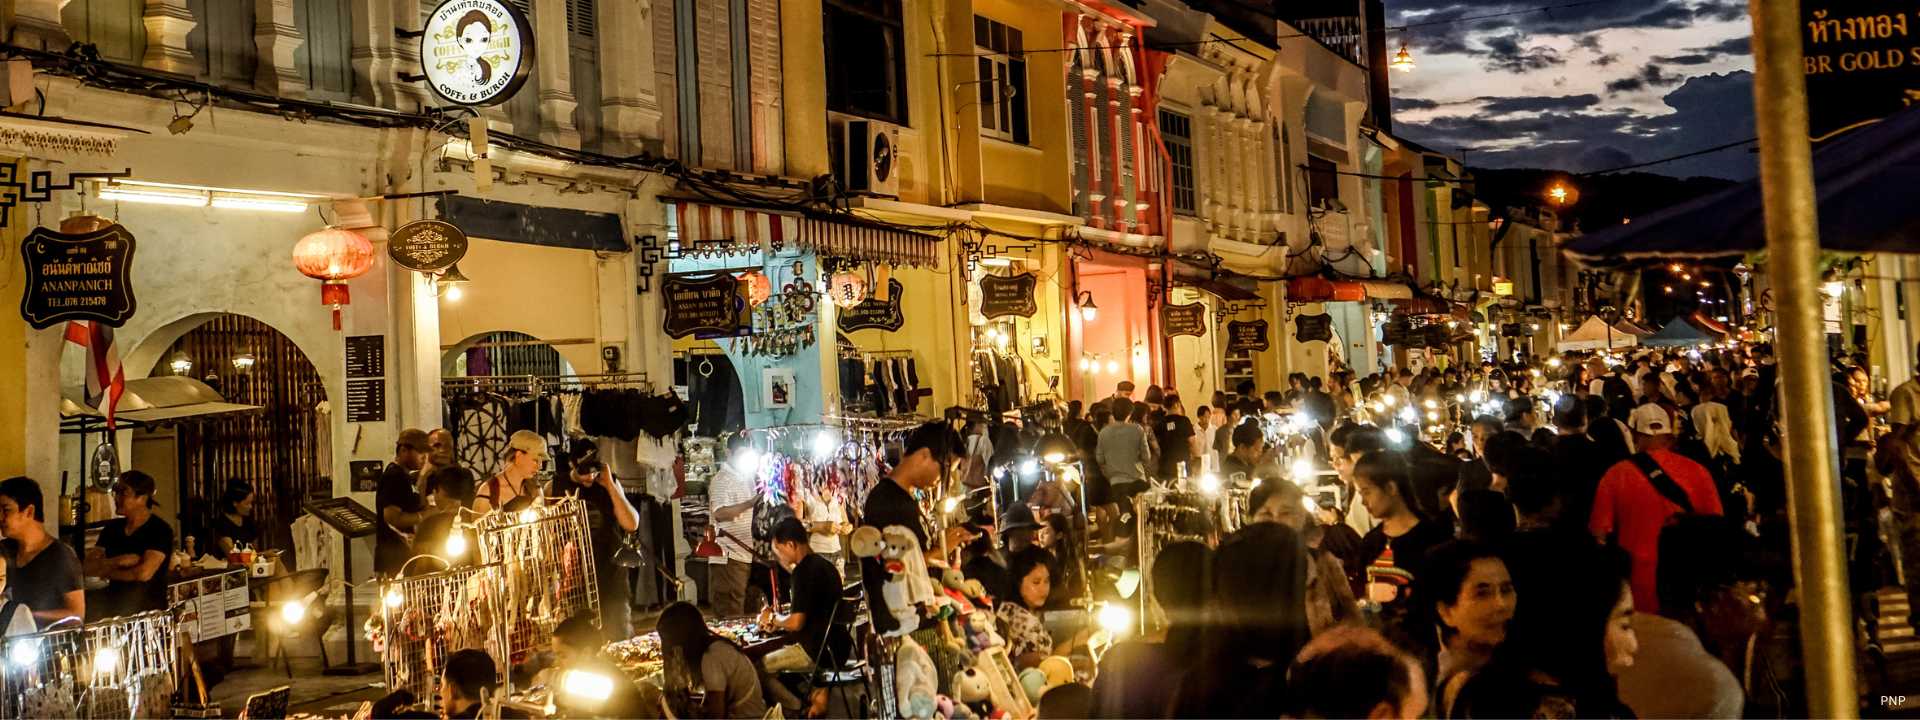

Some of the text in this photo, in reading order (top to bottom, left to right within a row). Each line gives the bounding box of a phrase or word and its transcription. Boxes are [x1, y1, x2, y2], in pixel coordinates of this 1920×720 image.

[1808, 8, 1908, 43] ห้างทอง
[1840, 49, 1905, 71] GOLD
[470, 93, 477, 101] &
[480, 71, 511, 100] BURGH
[41, 279, 113, 292] ANANPANICH
